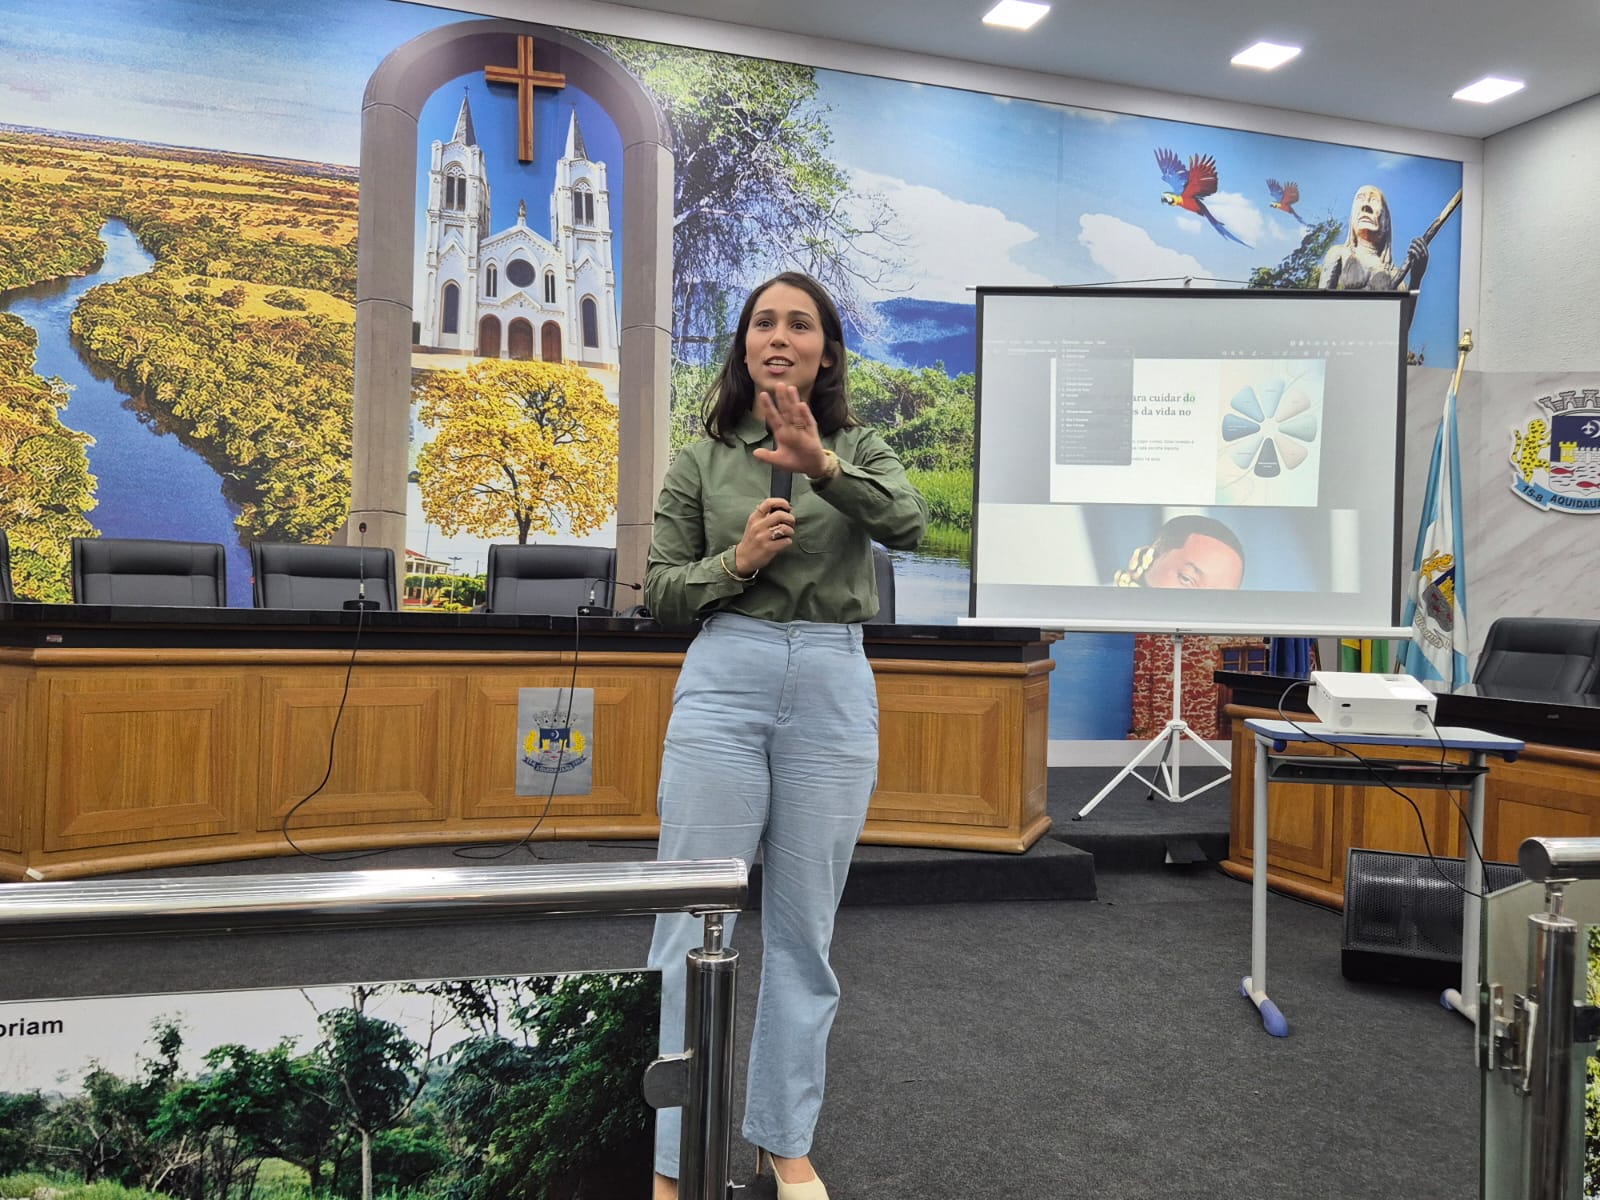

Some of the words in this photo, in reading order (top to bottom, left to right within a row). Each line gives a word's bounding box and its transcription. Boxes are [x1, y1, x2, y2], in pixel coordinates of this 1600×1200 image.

[1149, 393, 1181, 402] cuidar
[1183, 393, 1196, 402] do
[1141, 406, 1153, 416] da
[1155, 406, 1176, 416] vida
[1179, 408, 1191, 416] no
[1522, 485, 1543, 502] 15-8
